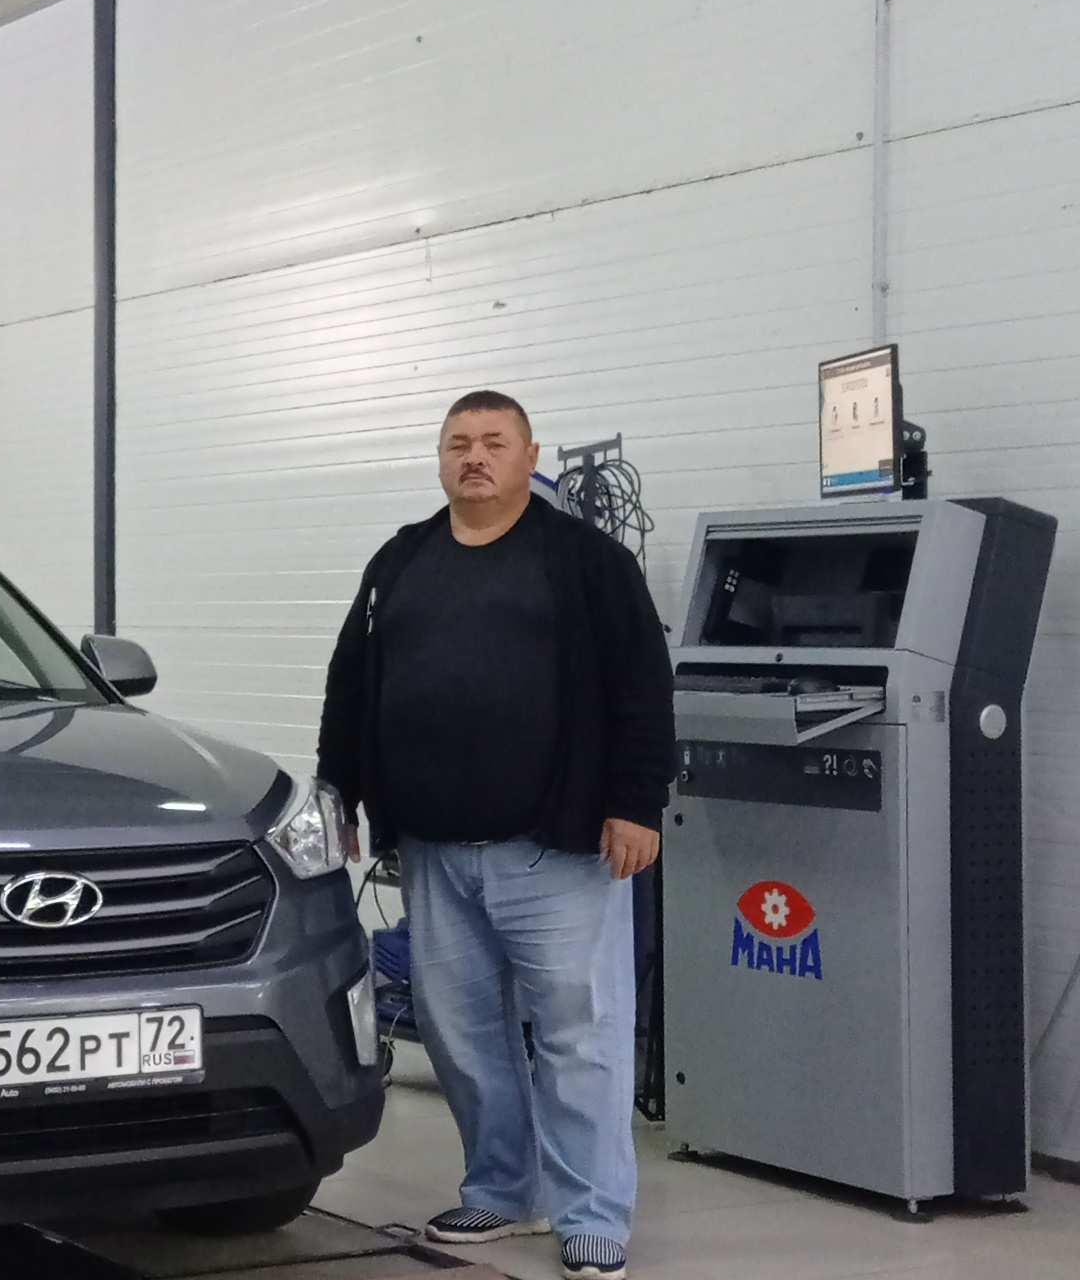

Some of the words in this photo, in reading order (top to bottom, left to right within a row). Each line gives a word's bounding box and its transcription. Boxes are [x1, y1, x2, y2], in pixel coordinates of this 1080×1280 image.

[731, 916, 824, 980] MAHA
[145, 1015, 186, 1052] 72
[142, 1052, 173, 1067] RUS
[0, 1088, 19, 1098] Auto
